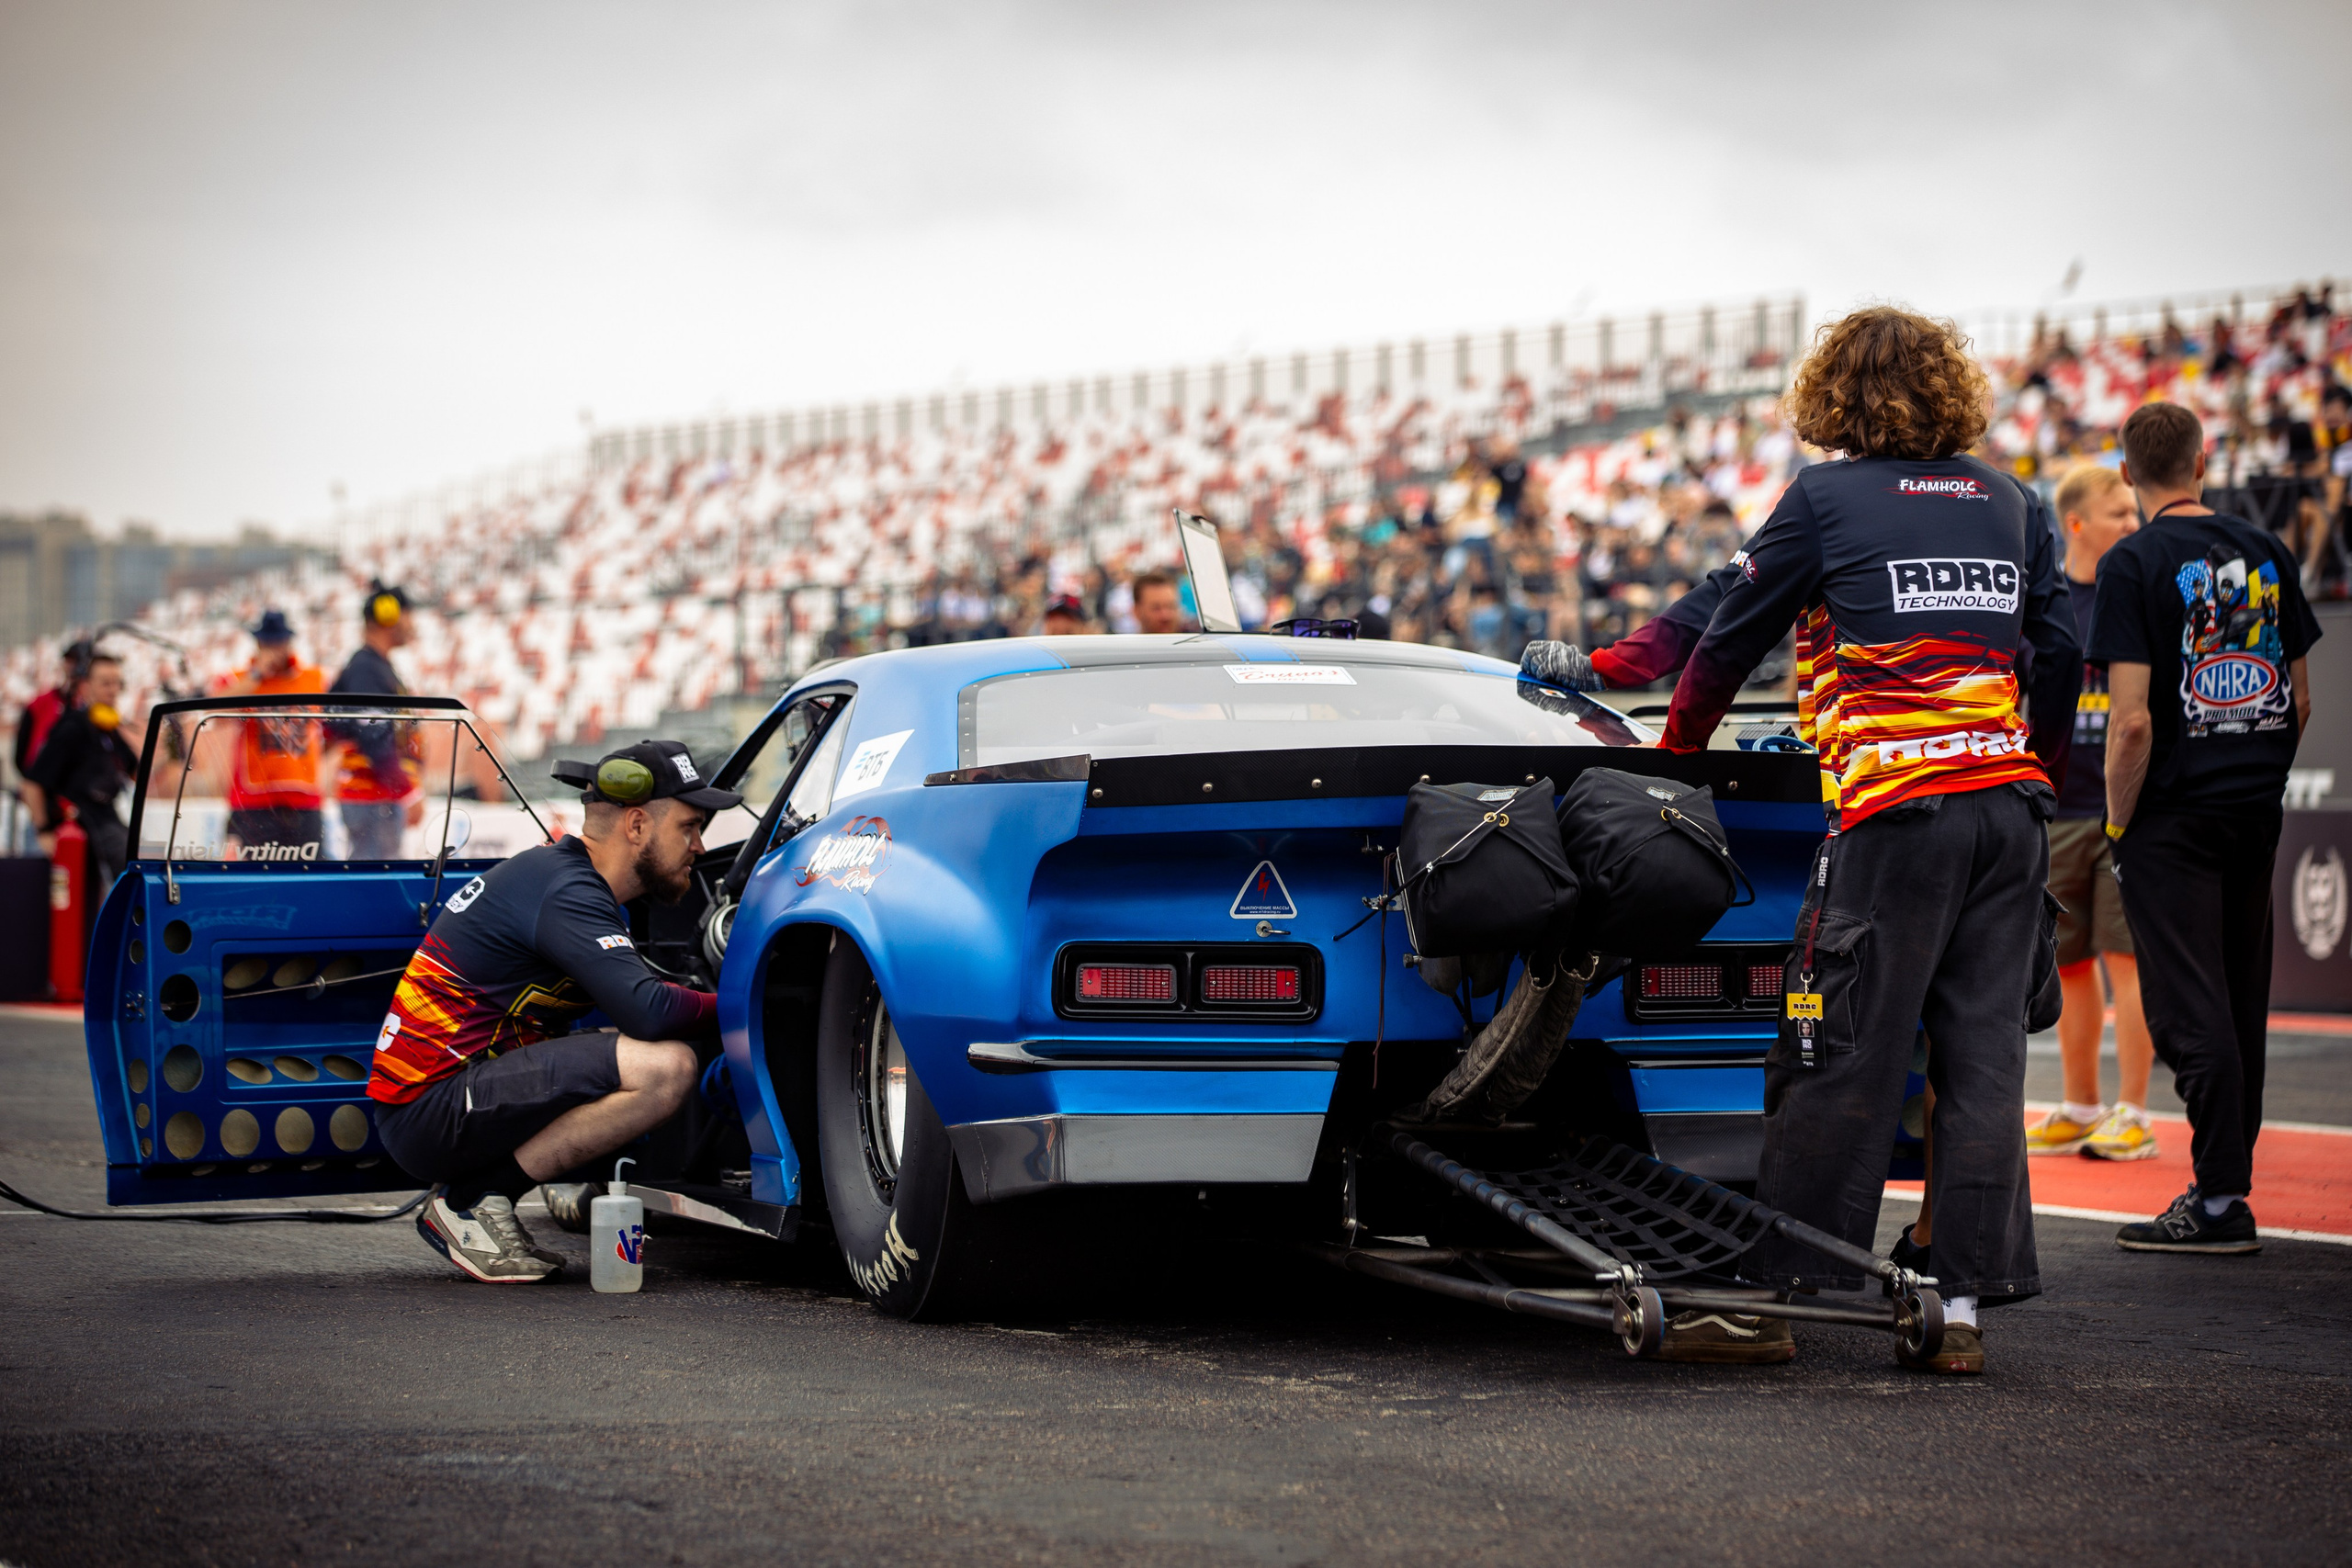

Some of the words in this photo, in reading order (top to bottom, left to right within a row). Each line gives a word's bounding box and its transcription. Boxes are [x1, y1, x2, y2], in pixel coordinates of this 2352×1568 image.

[1899, 479, 1976, 492] FLAMHOLC
[1956, 491, 1989, 502] Racing
[1893, 561, 2017, 595] RDRC
[1898, 596, 2015, 610] TECHNOLOGY
[2200, 662, 2261, 699] NHRA
[839, 870, 876, 896] Racing
